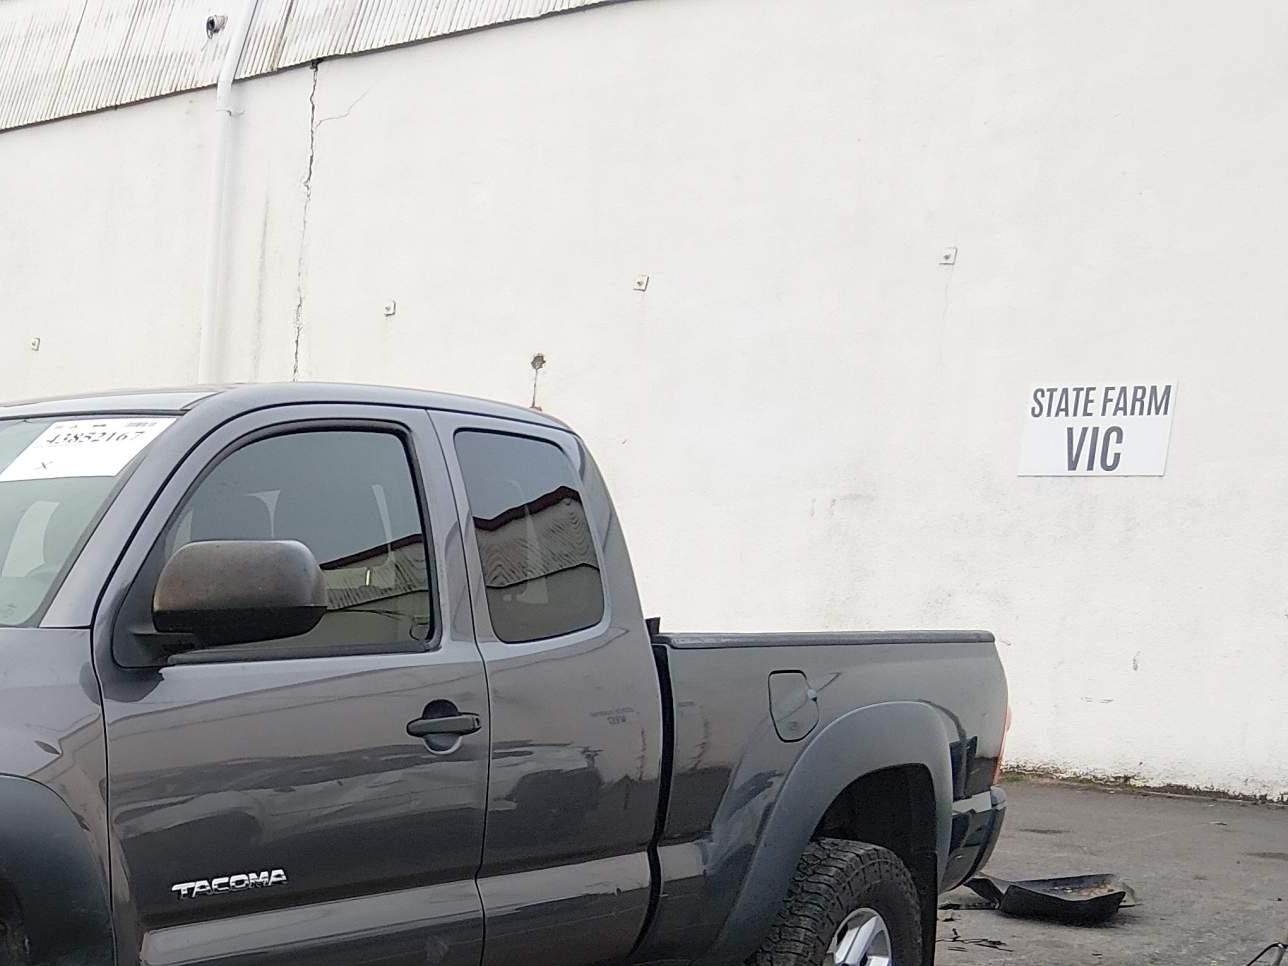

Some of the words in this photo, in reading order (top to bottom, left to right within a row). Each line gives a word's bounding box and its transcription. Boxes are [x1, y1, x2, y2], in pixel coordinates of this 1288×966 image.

[1031, 386, 1096, 418] STATE
[1100, 384, 1172, 417] FARM
[1066, 425, 1124, 472] VIC
[171, 868, 288, 899] TACOMA
